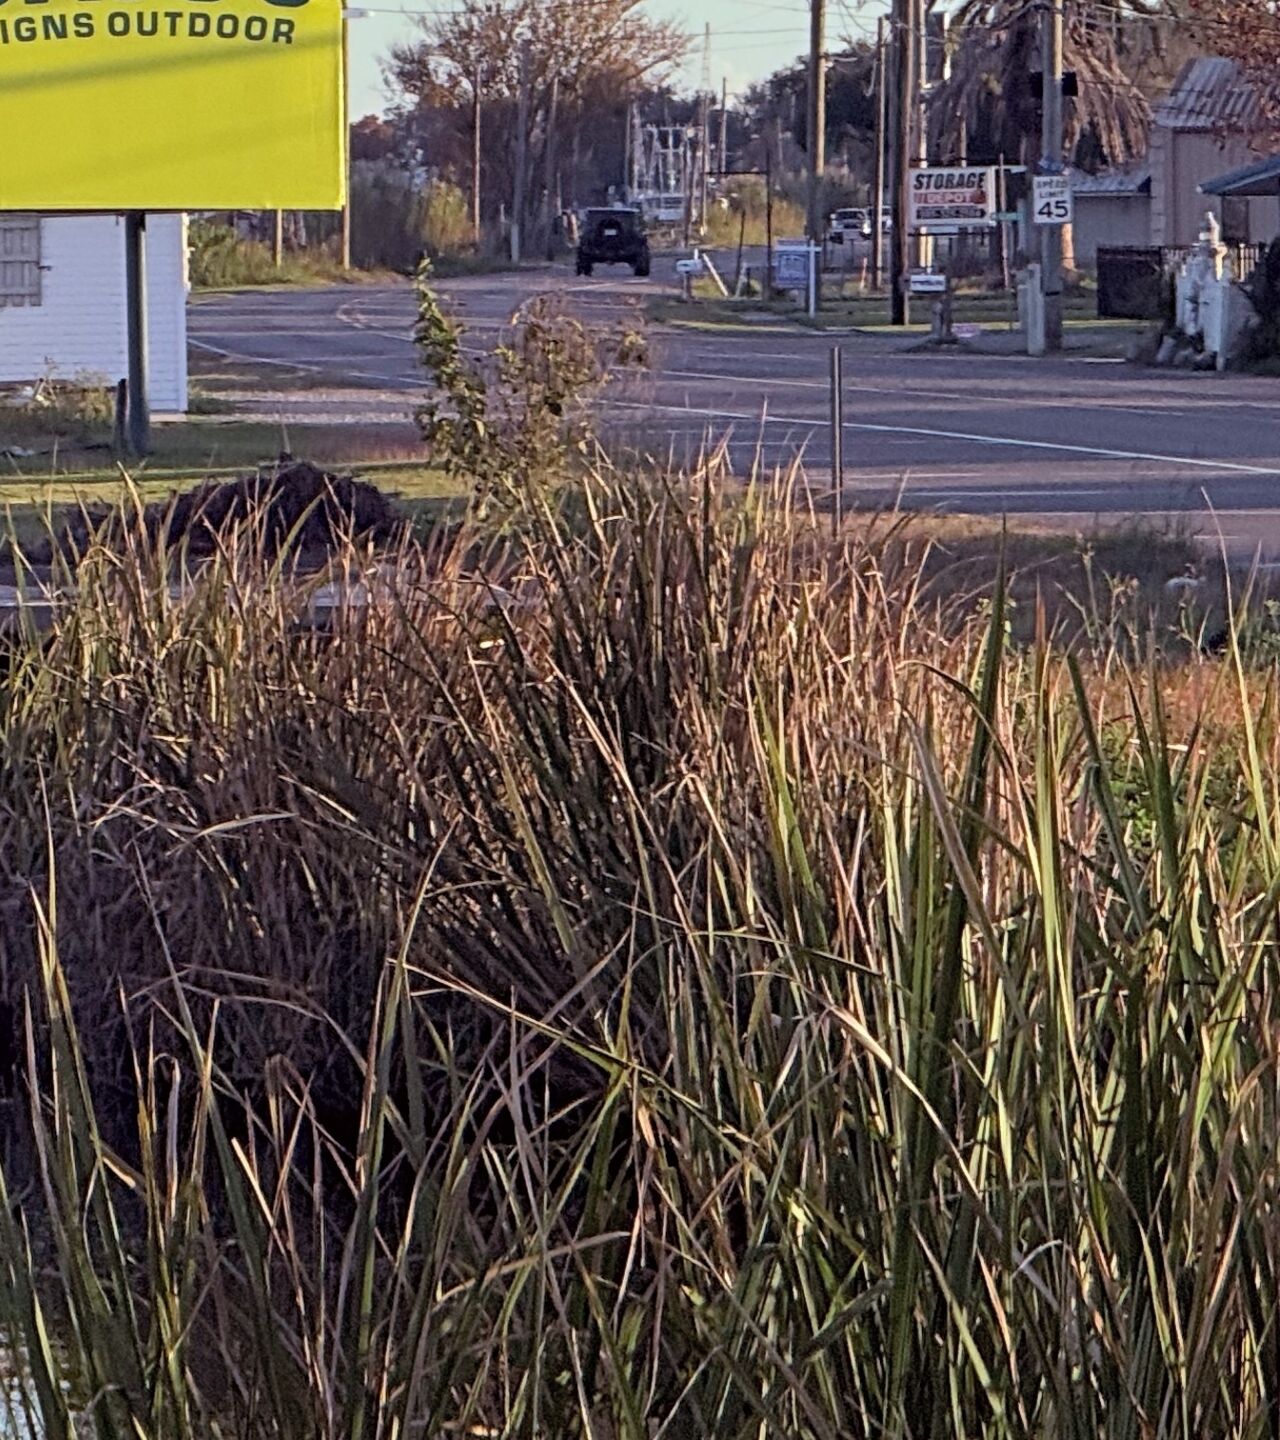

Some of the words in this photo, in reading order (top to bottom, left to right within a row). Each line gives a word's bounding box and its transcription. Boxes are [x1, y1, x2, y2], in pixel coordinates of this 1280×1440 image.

[107, 11, 296, 45] OUTDOOR
[913, 172, 986, 191] STORAGE
[1036, 178, 1068, 189] SPEED
[926, 191, 973, 203] DEPOT
[1039, 189, 1065, 199] LIMIT
[1037, 200, 1069, 218] 45
